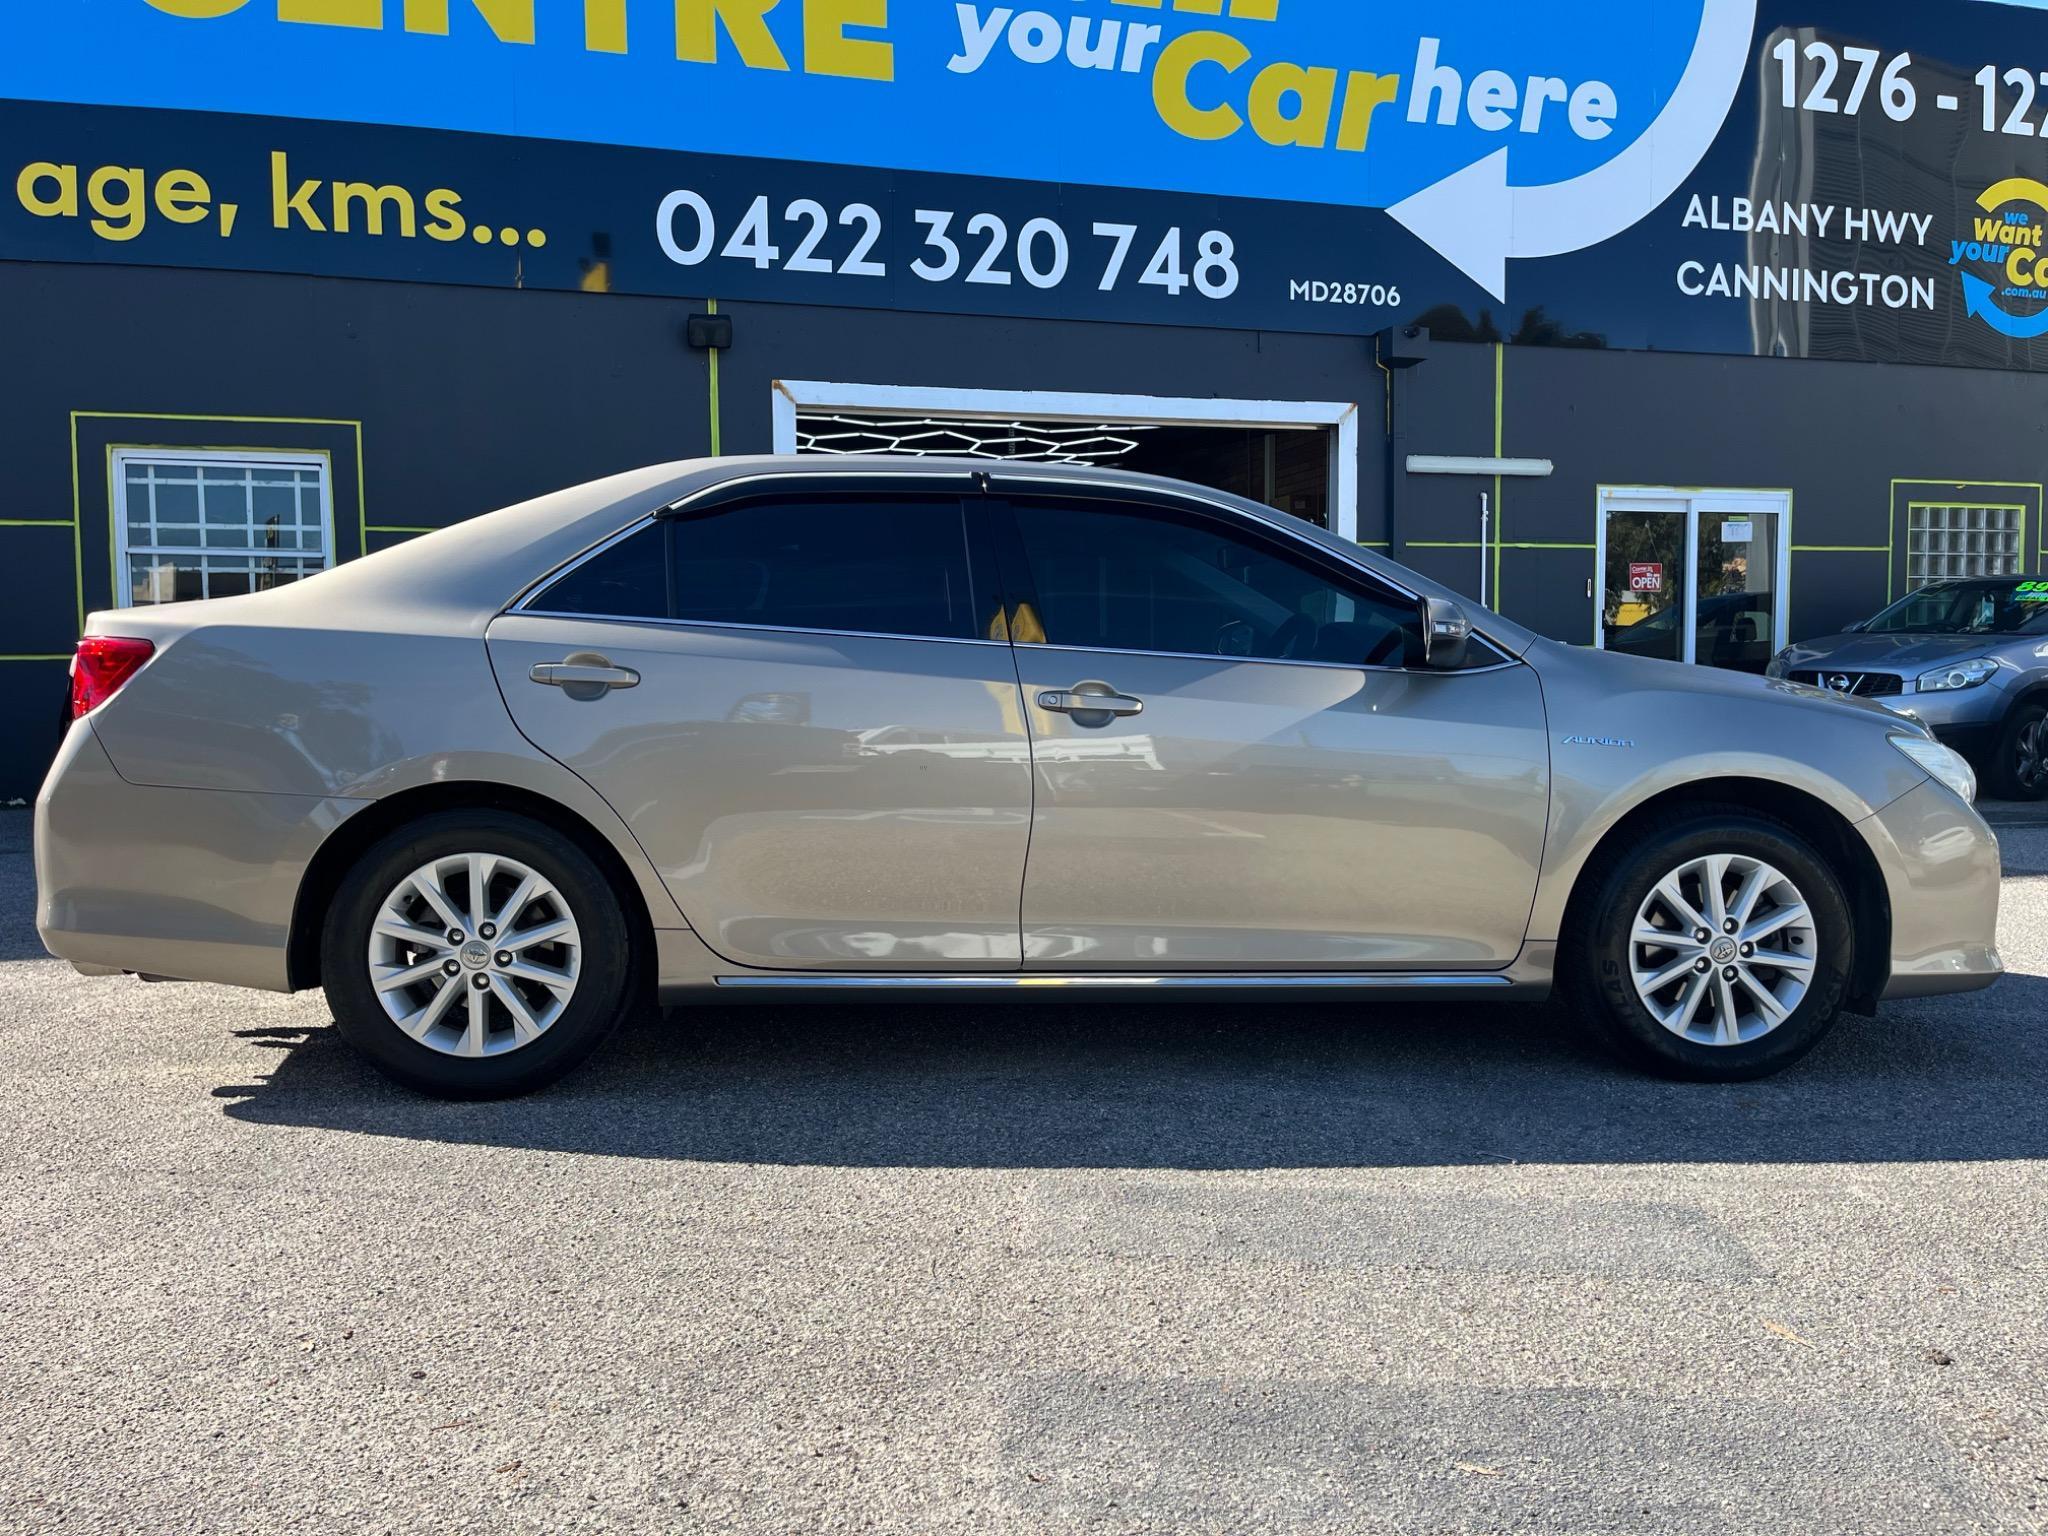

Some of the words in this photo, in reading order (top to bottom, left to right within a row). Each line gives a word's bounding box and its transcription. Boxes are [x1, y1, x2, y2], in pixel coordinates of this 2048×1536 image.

[946, 2, 1162, 74] your
[1153, 31, 1399, 152] Car
[1407, 37, 1617, 140] here
[1773, 38, 1917, 122] 1276
[1975, 64, 2048, 138] 12
[16, 161, 238, 241] age,
[271, 151, 547, 249] kms...
[1681, 193, 1835, 238] ALBANY
[1845, 207, 1934, 246] HWY
[2004, 212, 2029, 225] we
[656, 189, 886, 277] 0422
[909, 209, 1070, 290] 320
[1092, 222, 1240, 300] 748
[1974, 217, 2043, 247] Want
[1948, 240, 2010, 265] your
[1290, 279, 1401, 307] MD28706
[1676, 260, 1934, 311] CANNINGTON
[2001, 286, 2047, 300] .com.au
[1632, 576, 1660, 589] OPEN
